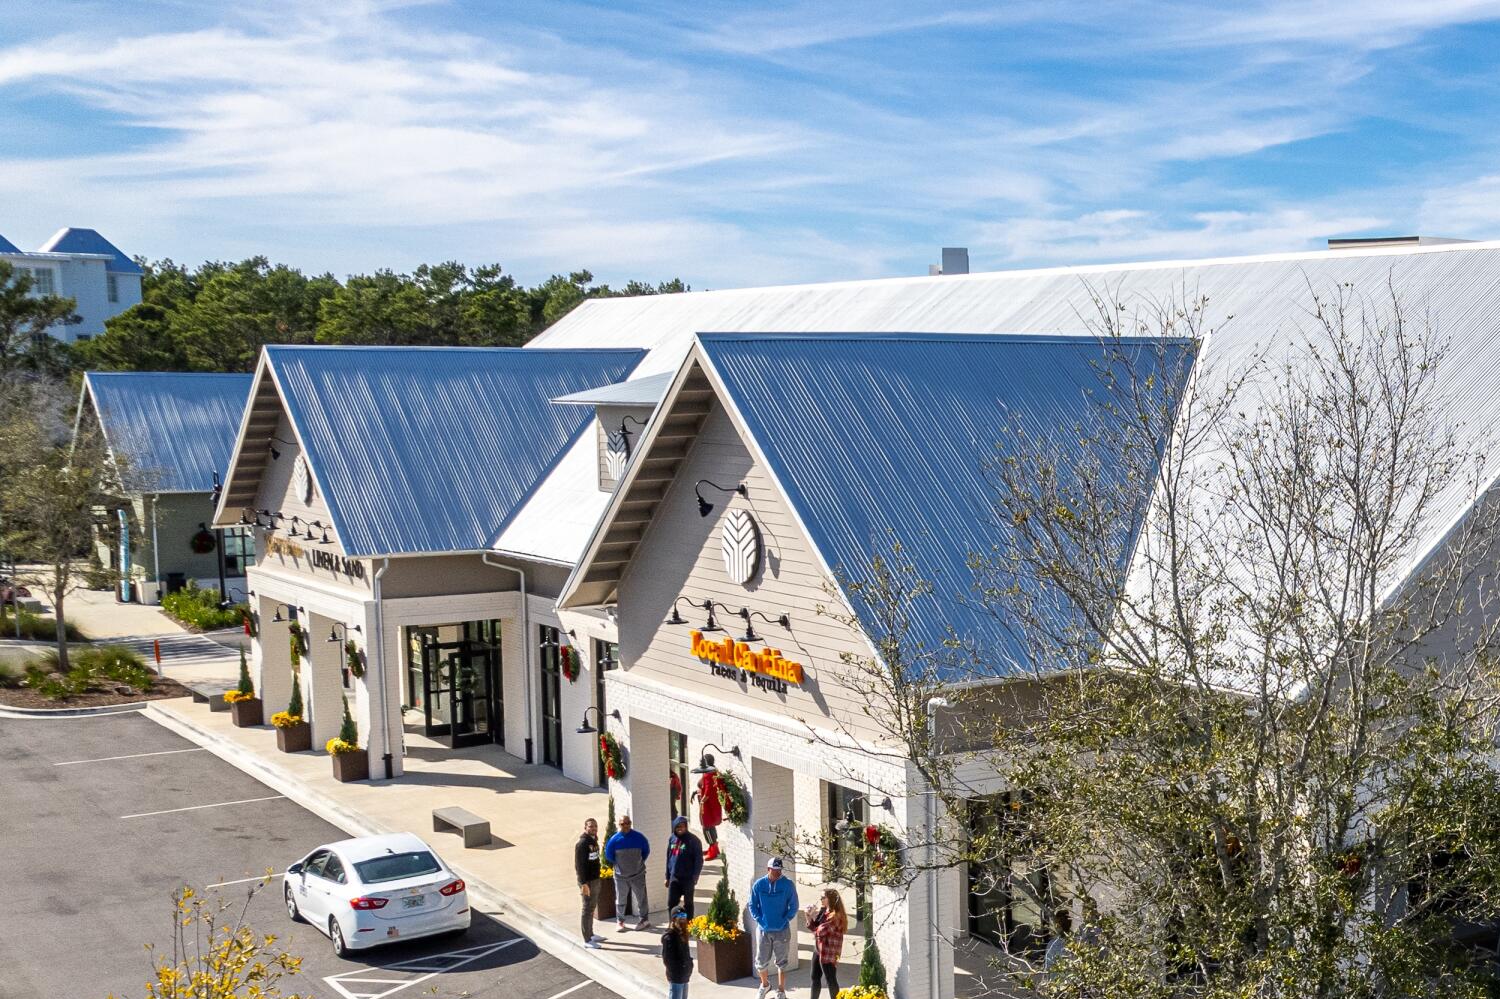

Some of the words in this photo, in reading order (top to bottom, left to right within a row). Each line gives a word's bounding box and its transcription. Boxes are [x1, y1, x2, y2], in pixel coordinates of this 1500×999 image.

[312, 549, 334, 571] LINEN
[689, 629, 736, 667] Local
[734, 641, 805, 685] Cantina
[710, 661, 736, 681] Tacos
[749, 671, 788, 694] Tequila
